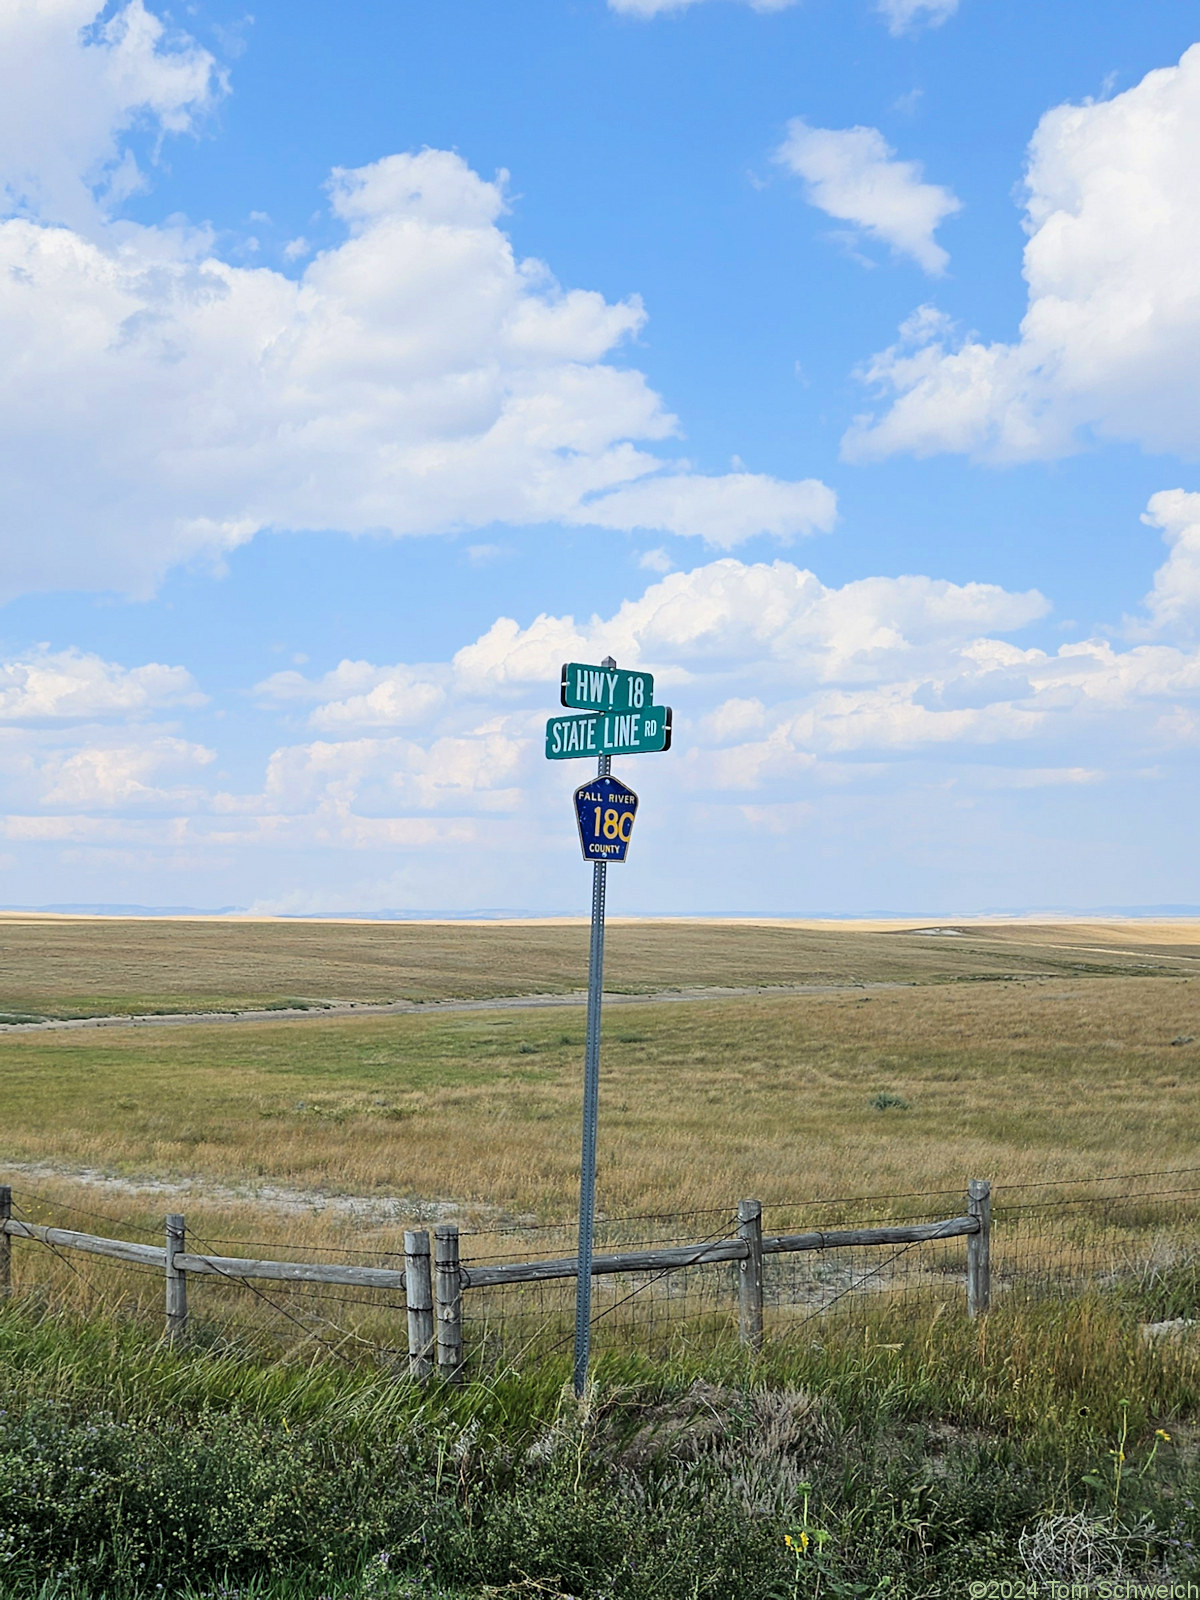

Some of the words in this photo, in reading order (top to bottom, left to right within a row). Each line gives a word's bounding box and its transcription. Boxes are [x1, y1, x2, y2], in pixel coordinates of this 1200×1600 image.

[576, 670, 618, 704] HWY
[628, 677, 644, 708] 18
[552, 719, 596, 754] STATE
[604, 714, 640, 748] LINE
[645, 721, 656, 736] RD
[579, 792, 603, 802] FALL
[609, 794, 635, 804] RIVER
[589, 844, 620, 854] COUNTY
